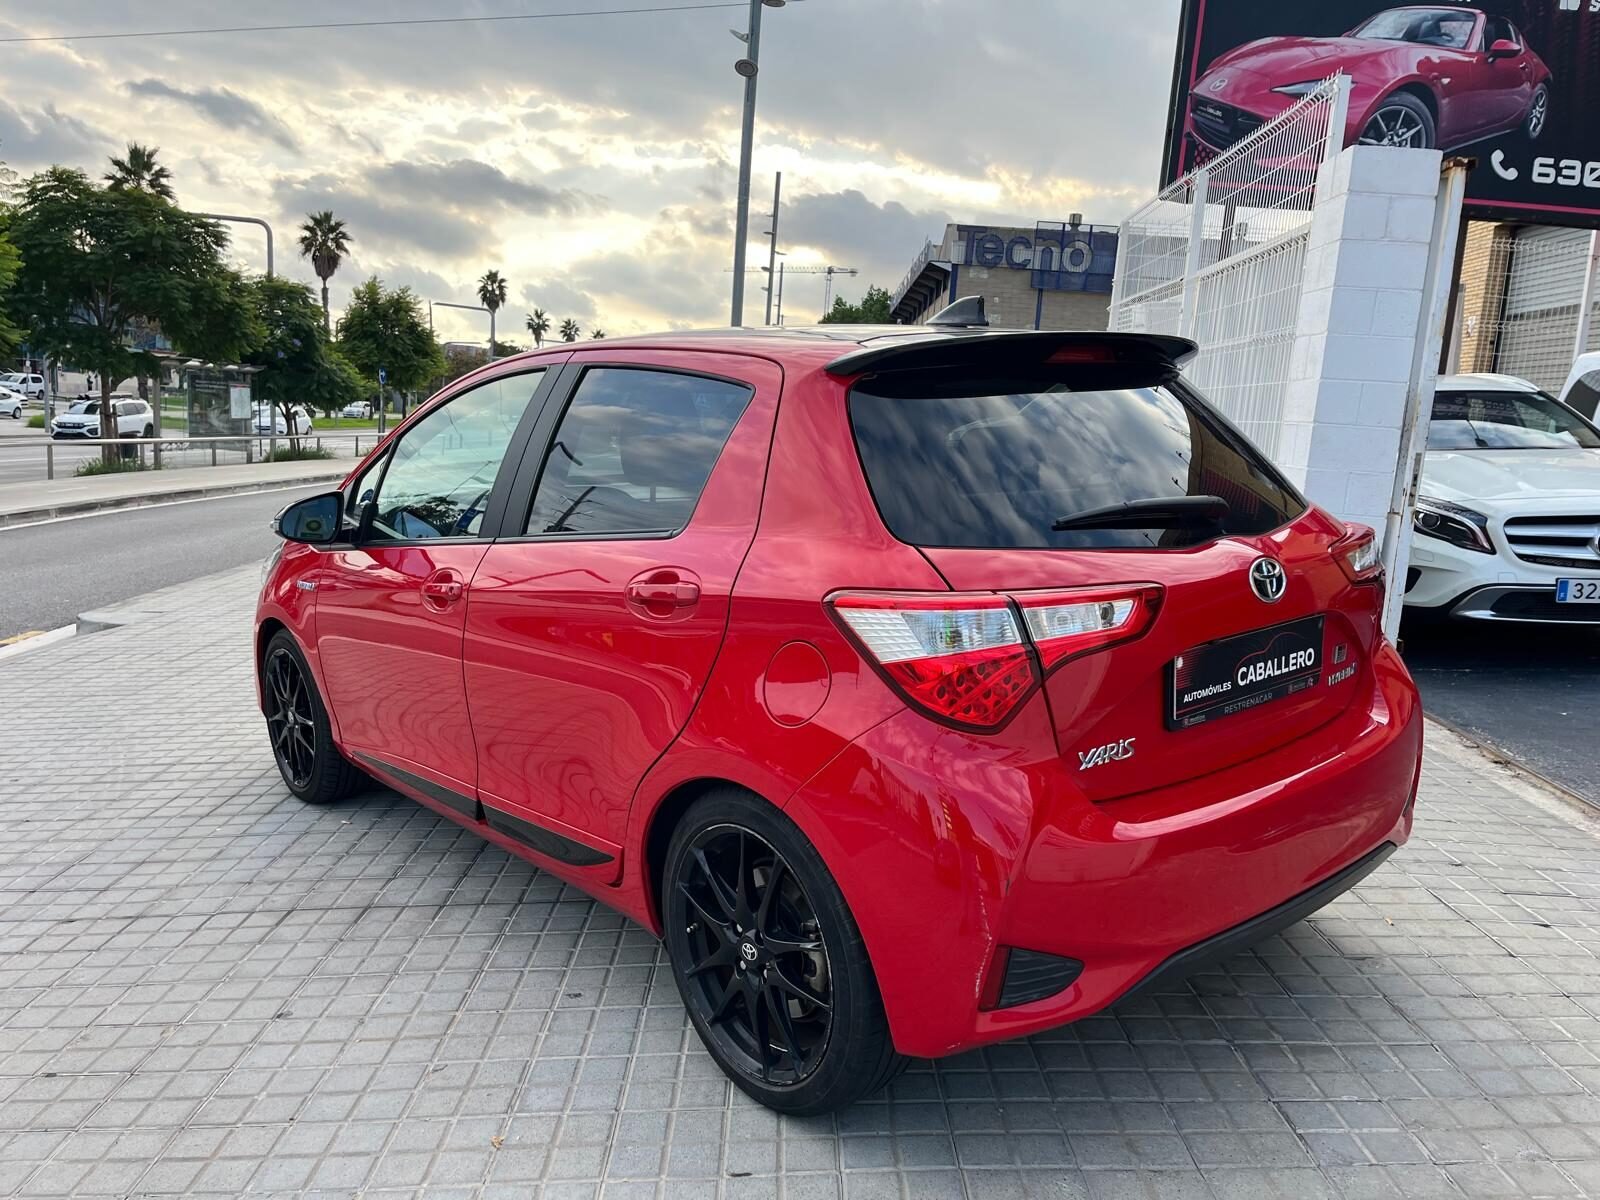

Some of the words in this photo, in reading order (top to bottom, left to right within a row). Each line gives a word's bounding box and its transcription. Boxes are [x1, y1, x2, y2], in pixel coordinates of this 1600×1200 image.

[957, 224, 1094, 273] Tecno
[1572, 582, 1600, 600] 32
[1183, 681, 1232, 703] AUTOMÓVILES
[1237, 647, 1315, 686] CABALLERO
